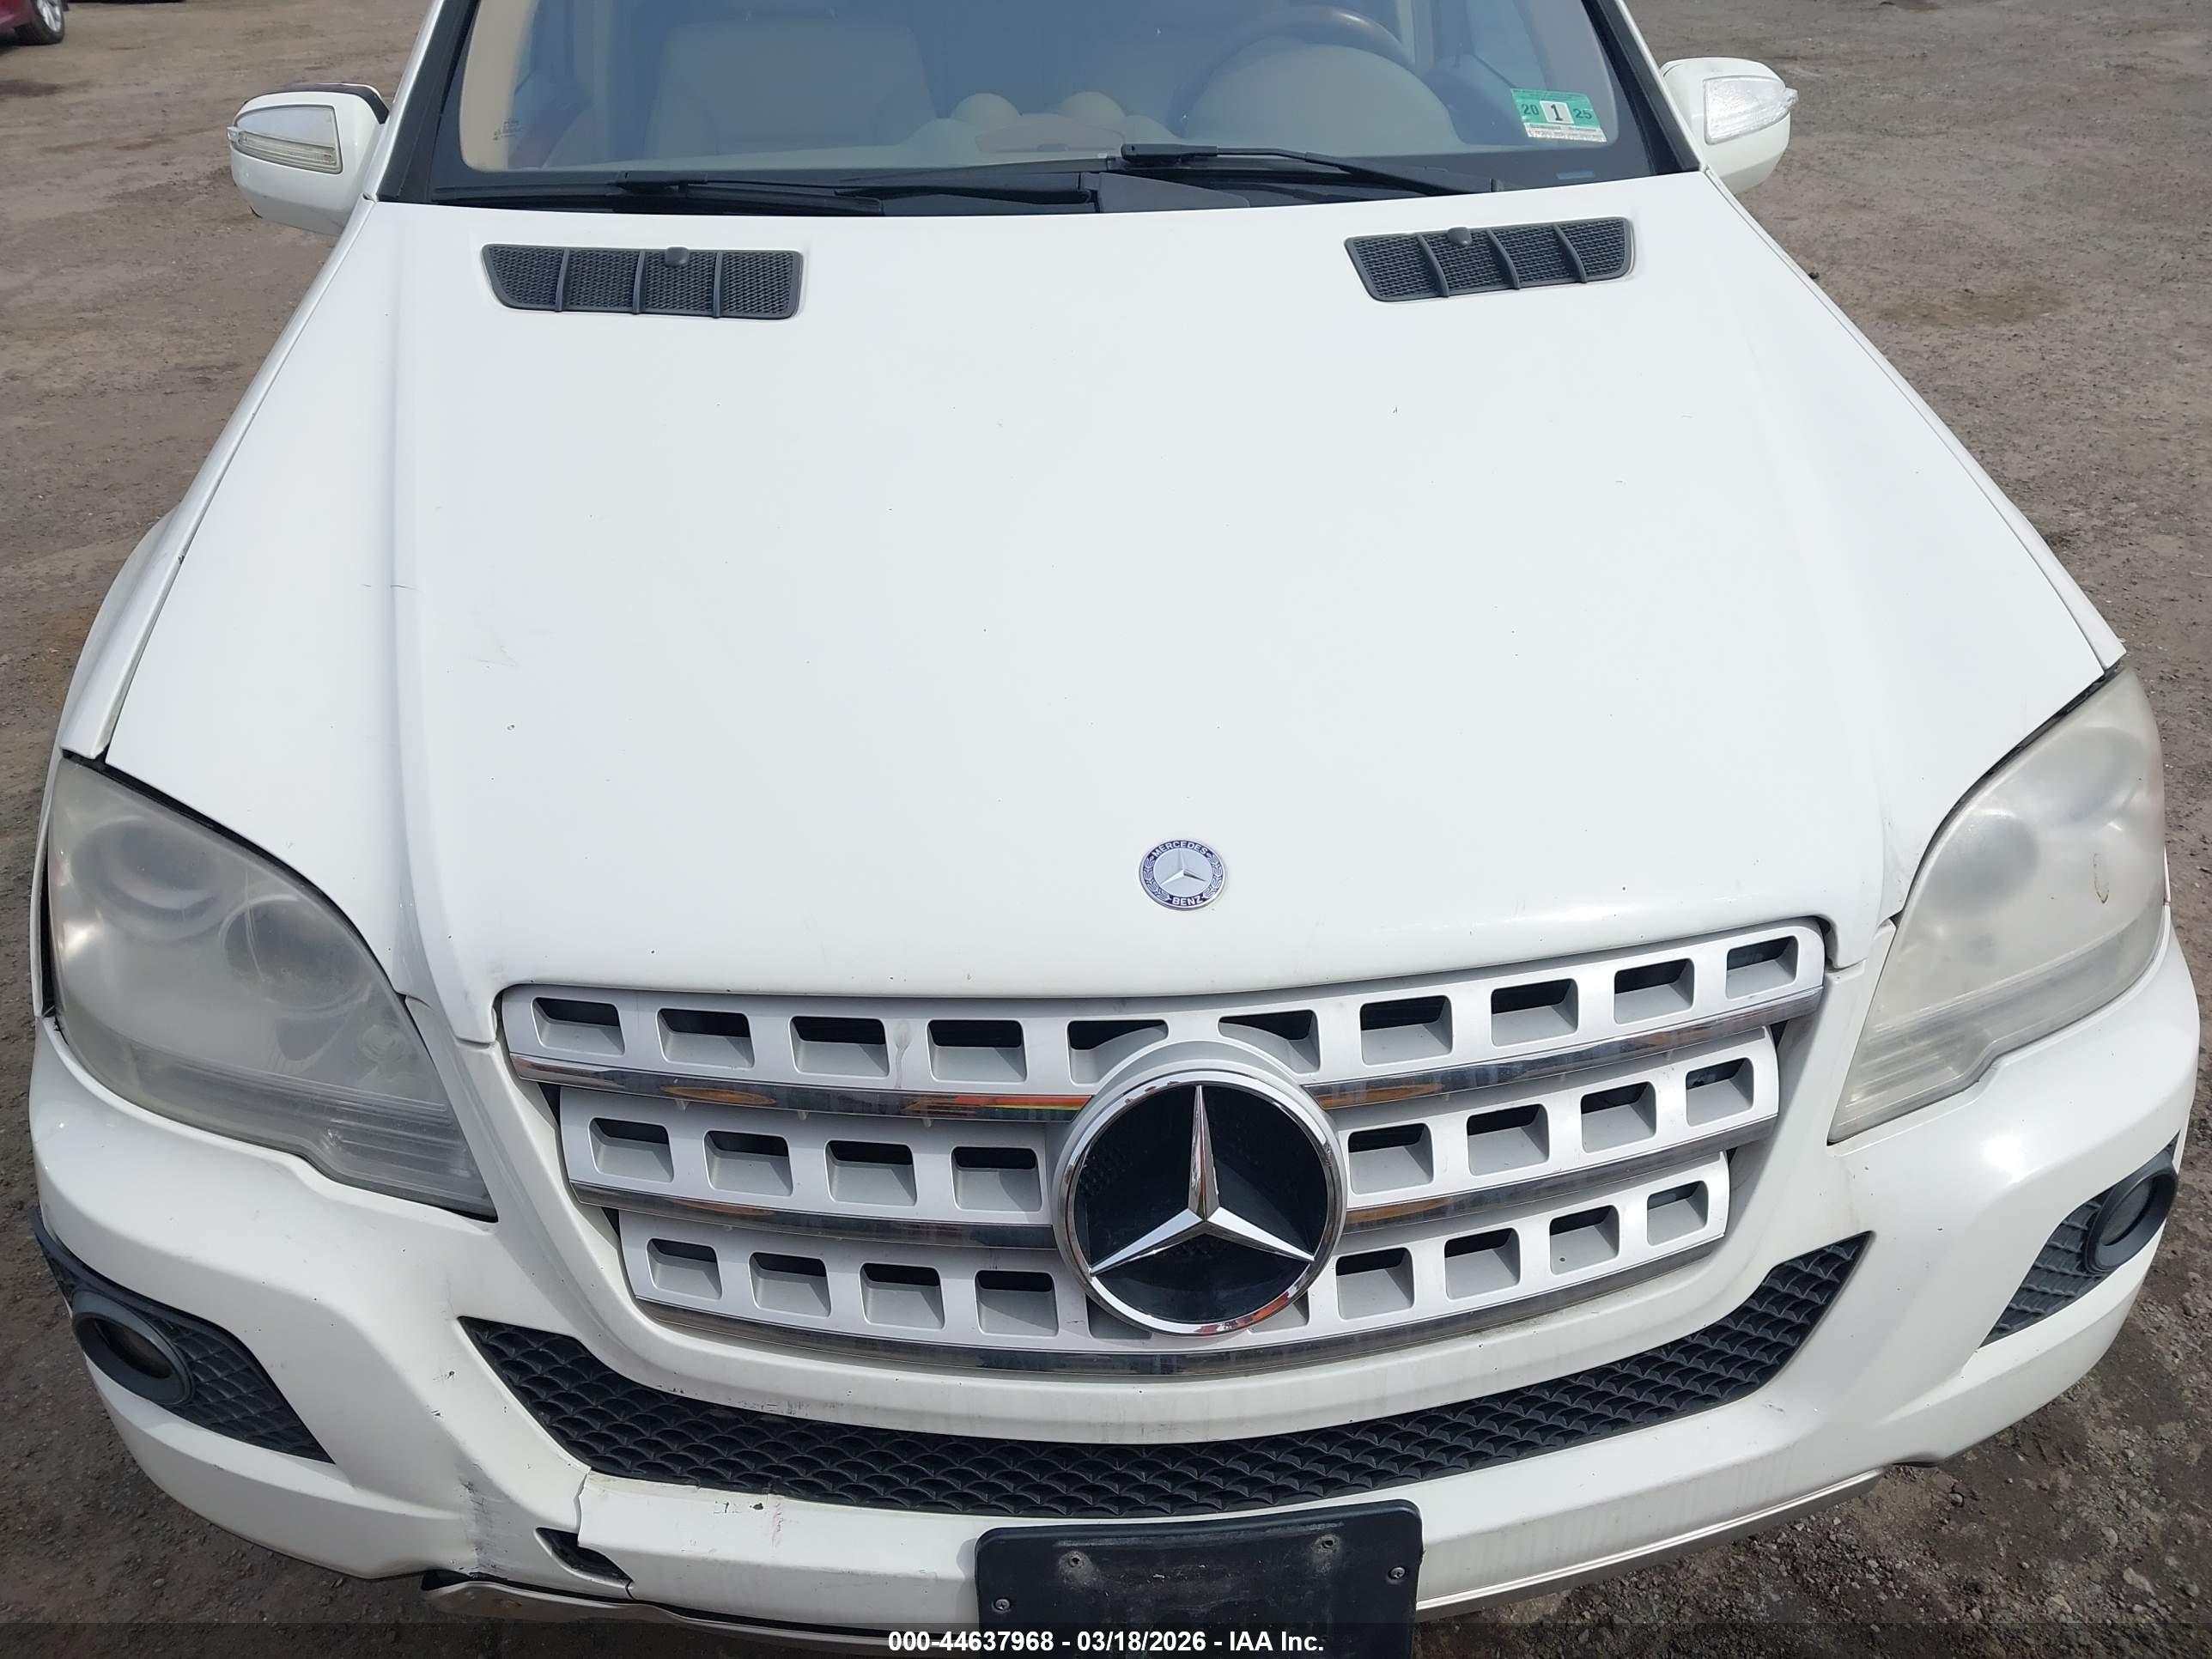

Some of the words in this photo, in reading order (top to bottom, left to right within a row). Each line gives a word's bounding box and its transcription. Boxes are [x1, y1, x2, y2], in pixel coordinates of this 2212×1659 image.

[1521, 103, 1540, 116] 20
[1550, 104, 1564, 121] 1
[1573, 108, 1593, 119] 25
[1152, 841, 1208, 858] MERCEDES
[1172, 895, 1204, 906] BENZ
